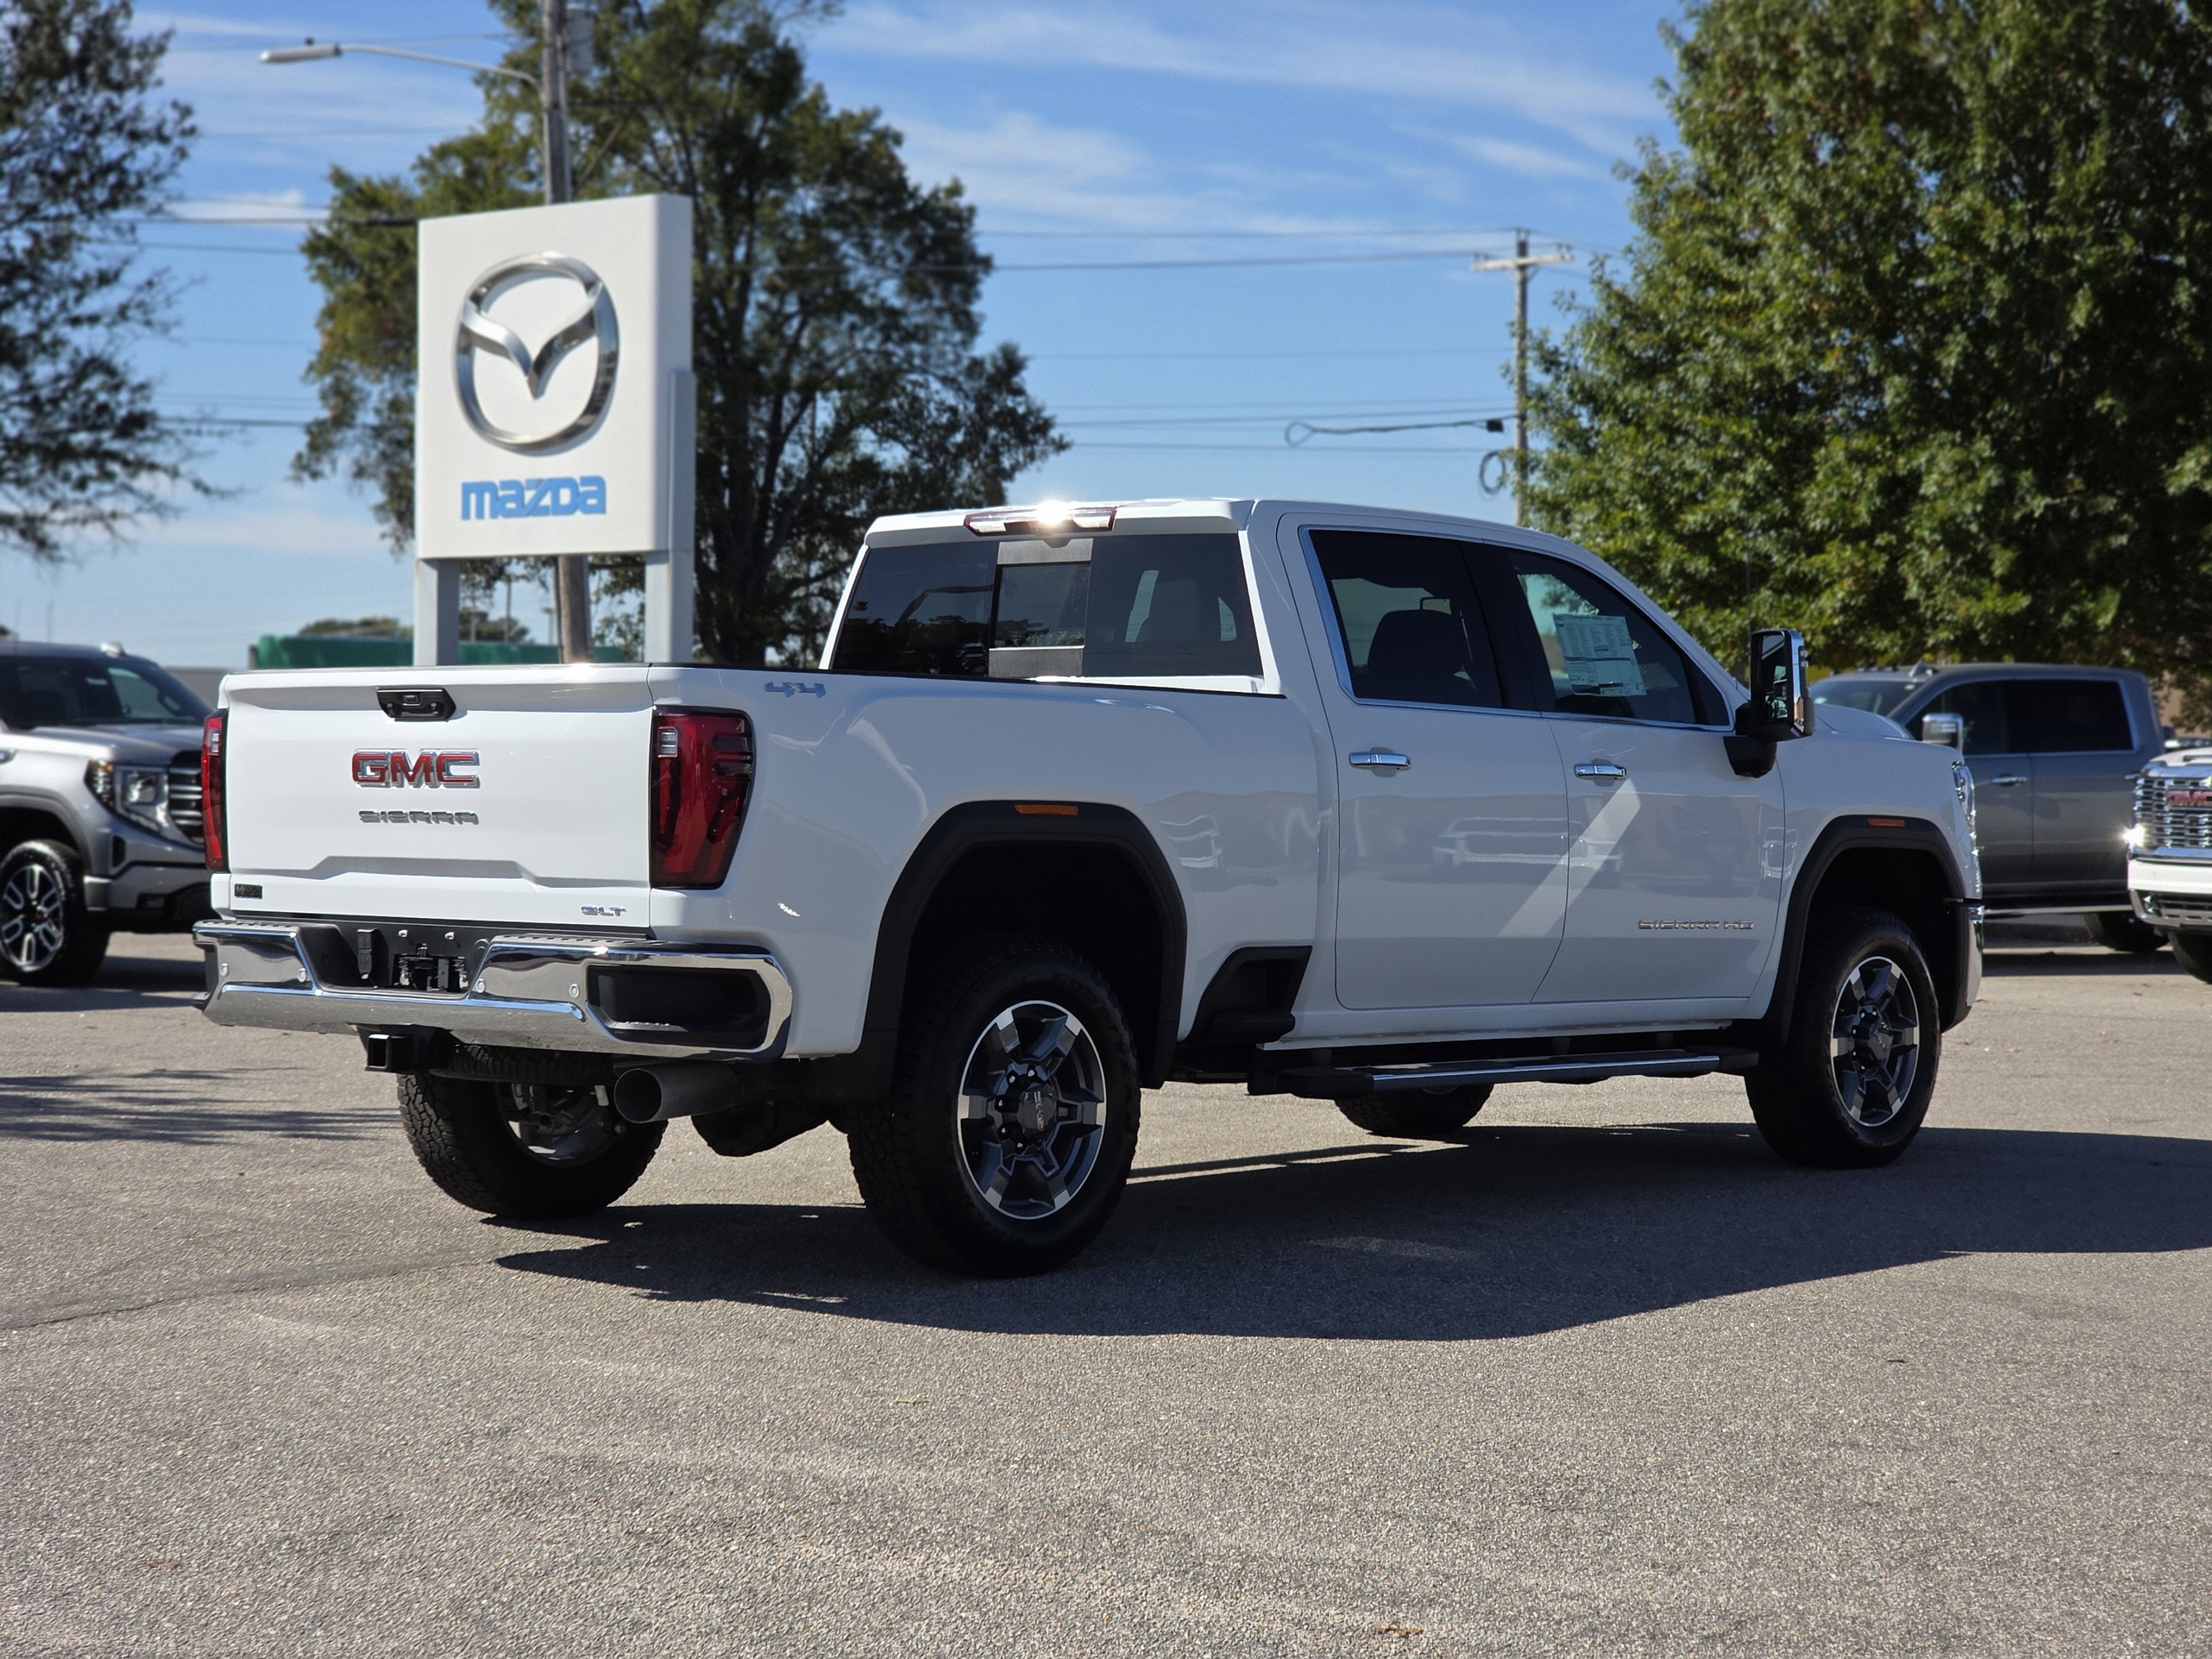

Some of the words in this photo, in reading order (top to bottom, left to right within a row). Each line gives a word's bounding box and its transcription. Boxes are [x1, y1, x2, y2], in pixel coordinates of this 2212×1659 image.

[352, 749, 481, 789] GMC
[2166, 790, 2212, 807] GMC
[358, 810, 479, 826] SIERRA
[581, 906, 627, 917] SLT
[1638, 920, 1720, 930] SIERRA
[1723, 920, 1755, 930] HD
[1033, 1090, 1045, 1132] GMC
